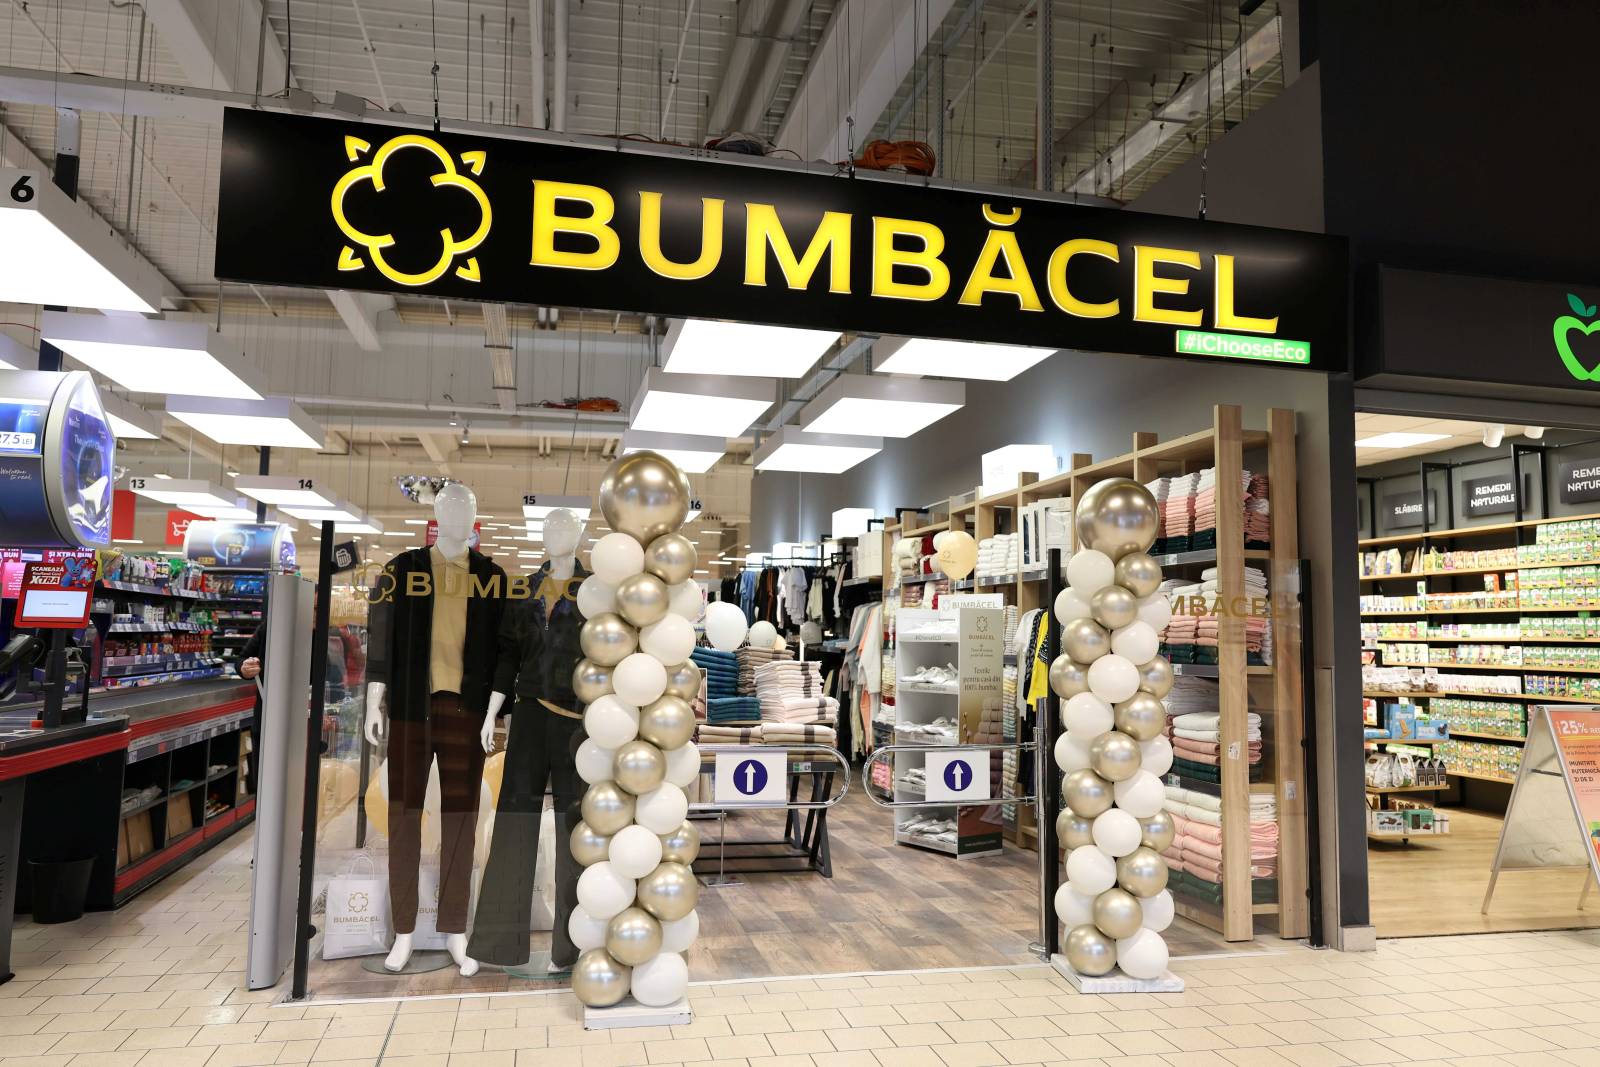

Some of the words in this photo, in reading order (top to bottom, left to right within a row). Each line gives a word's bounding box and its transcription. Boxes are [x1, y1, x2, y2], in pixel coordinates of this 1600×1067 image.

[10, 175, 35, 203] 6
[529, 179, 1280, 334] BUMBĂCEL
[1184, 333, 1307, 361] #iChooseEco
[0, 433, 21, 445] 7,5
[1573, 466, 1600, 479] REME
[130, 479, 146, 489] 13
[298, 479, 313, 490] 14
[1475, 482, 1512, 496] REMEDII
[1567, 479, 1600, 492] NATUR
[523, 495, 536, 505] 15
[690, 500, 702, 510] 16
[1470, 493, 1515, 508] NATURALE
[405, 567, 586, 601] BUMBĂC
